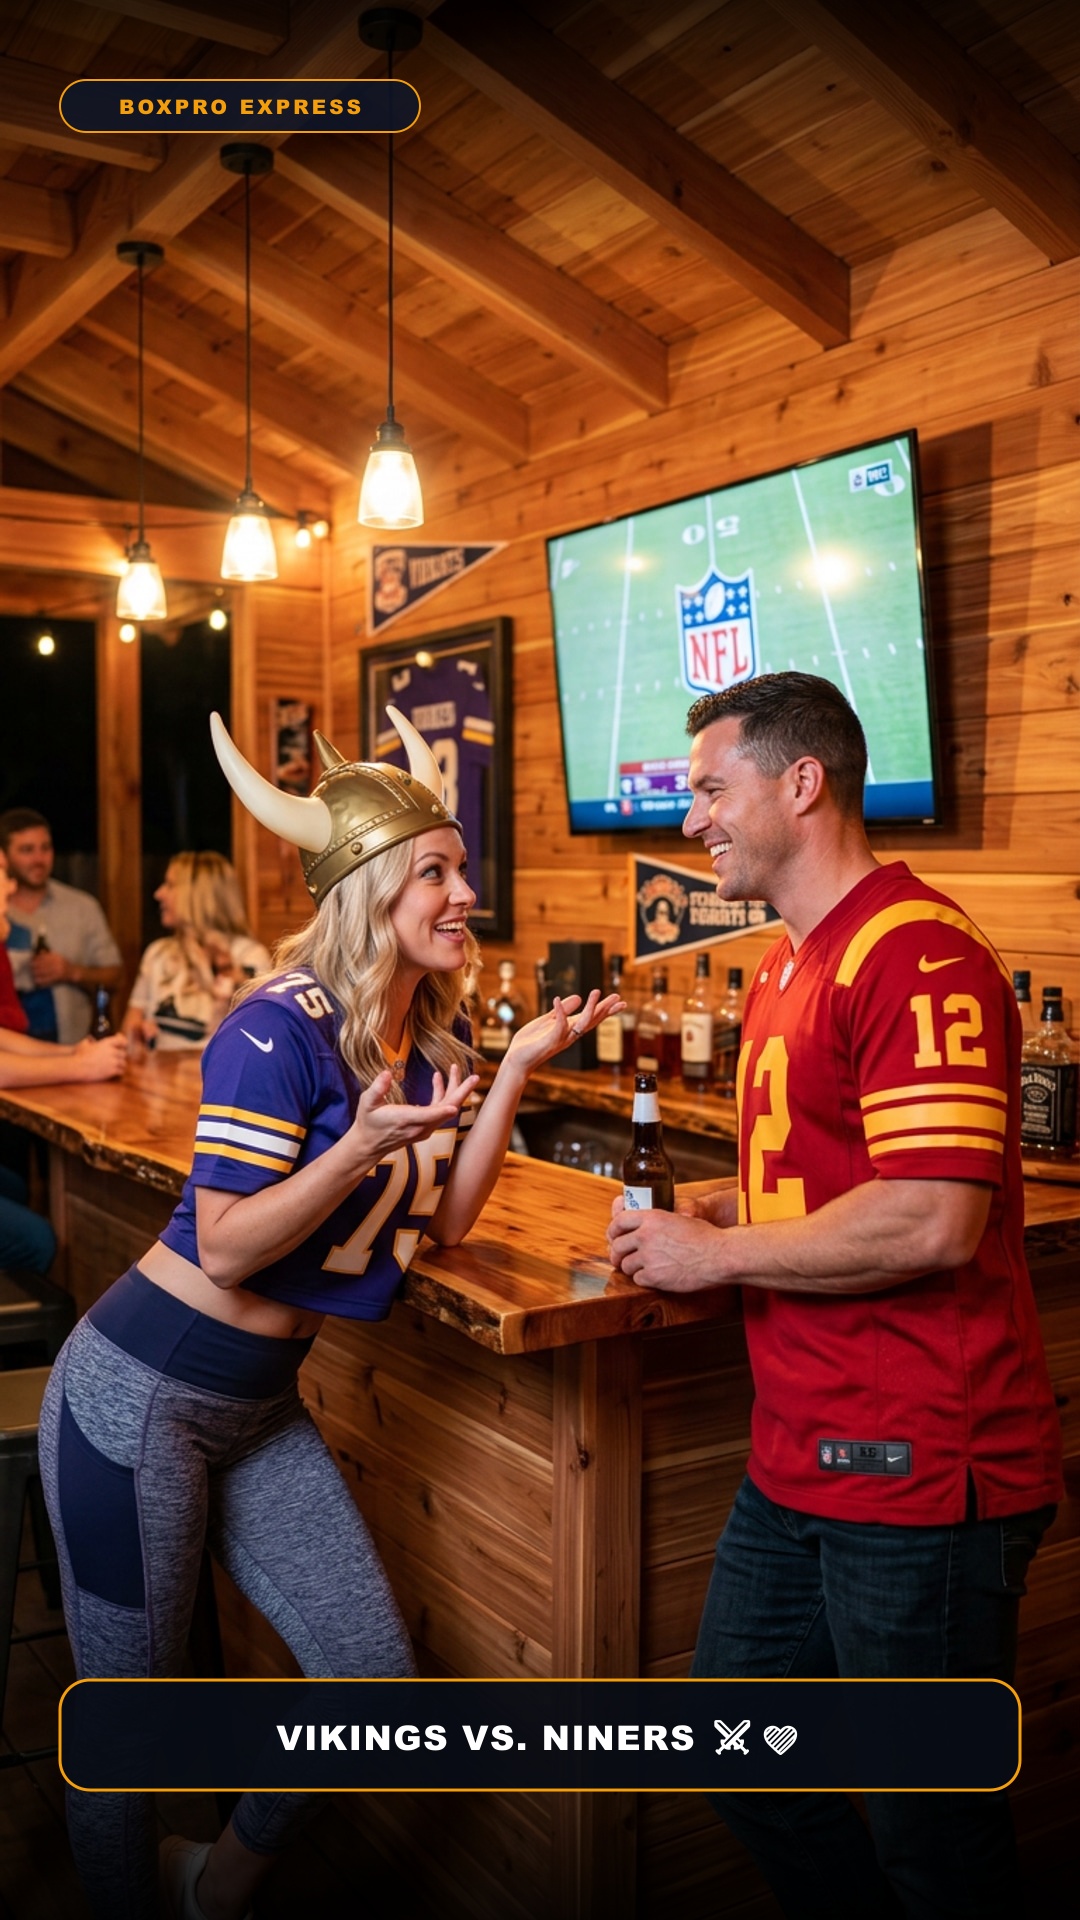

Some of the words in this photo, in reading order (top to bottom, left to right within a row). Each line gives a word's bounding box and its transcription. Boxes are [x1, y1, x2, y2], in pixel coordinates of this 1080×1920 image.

[690, 626, 748, 685] NFL
[265, 973, 334, 1019] 75
[910, 993, 987, 1069] 12
[735, 1035, 807, 1225] 12
[321, 1128, 457, 1276] 75
